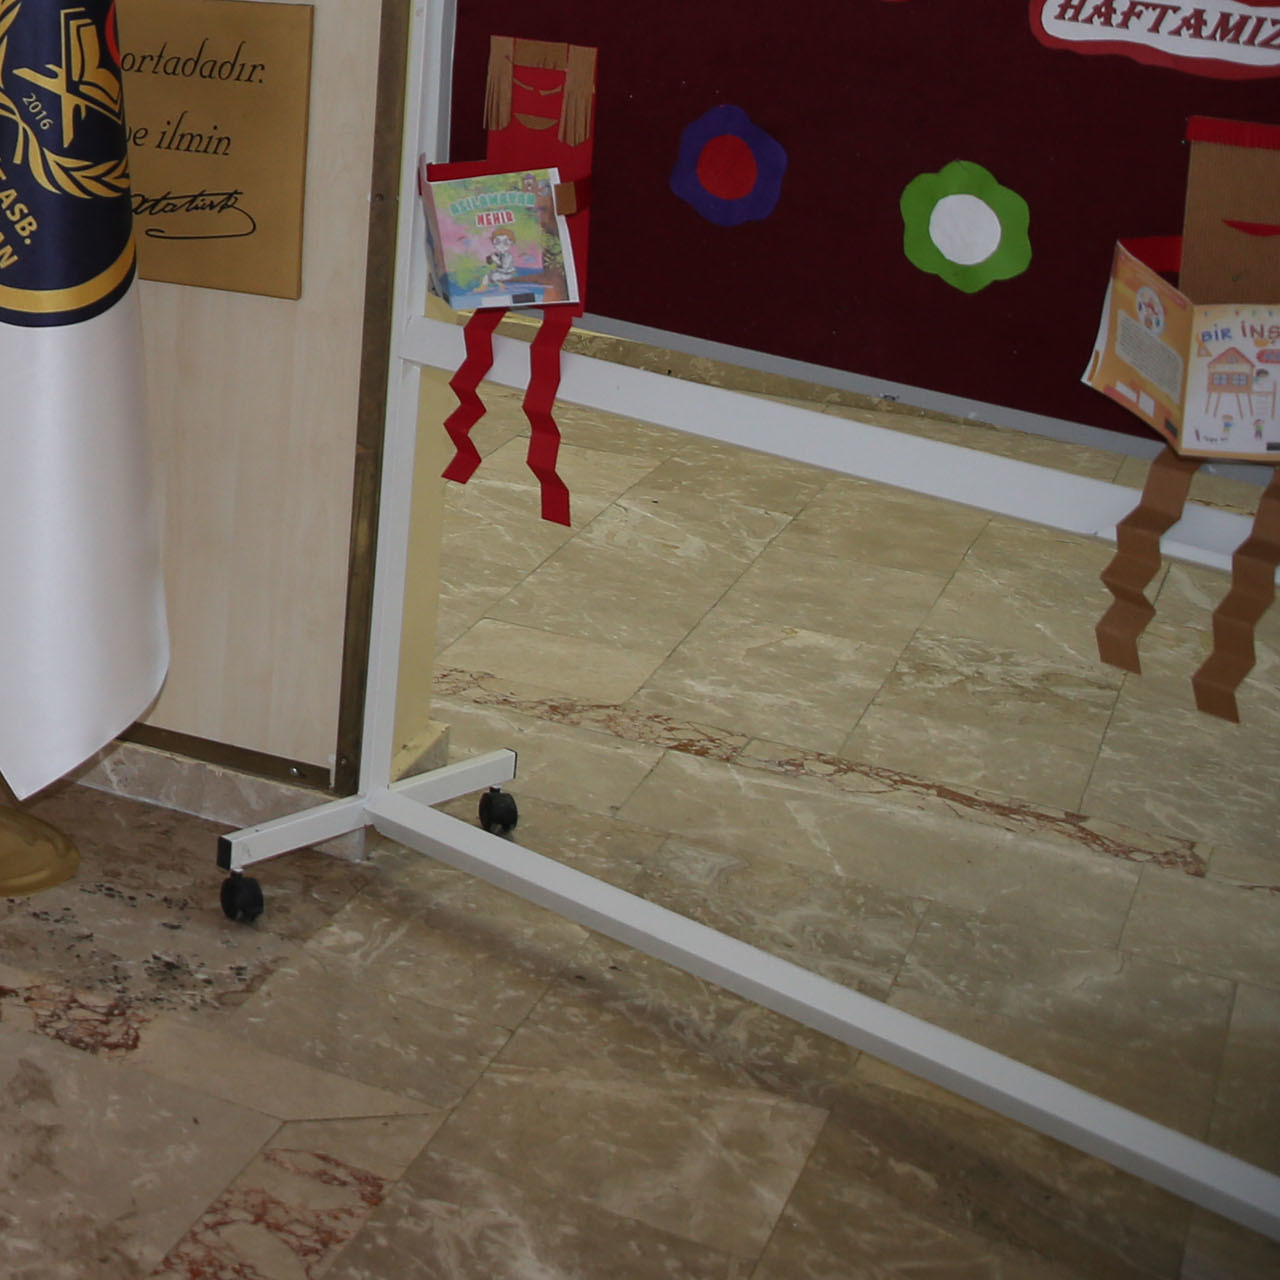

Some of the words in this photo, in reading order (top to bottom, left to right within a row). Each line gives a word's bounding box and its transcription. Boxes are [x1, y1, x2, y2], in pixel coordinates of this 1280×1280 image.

[120, 37, 265, 84] ortadadır.
[22, 92, 54, 132] 2016
[155, 110, 232, 157] ilmin
[1201, 323, 1233, 343] BİR
